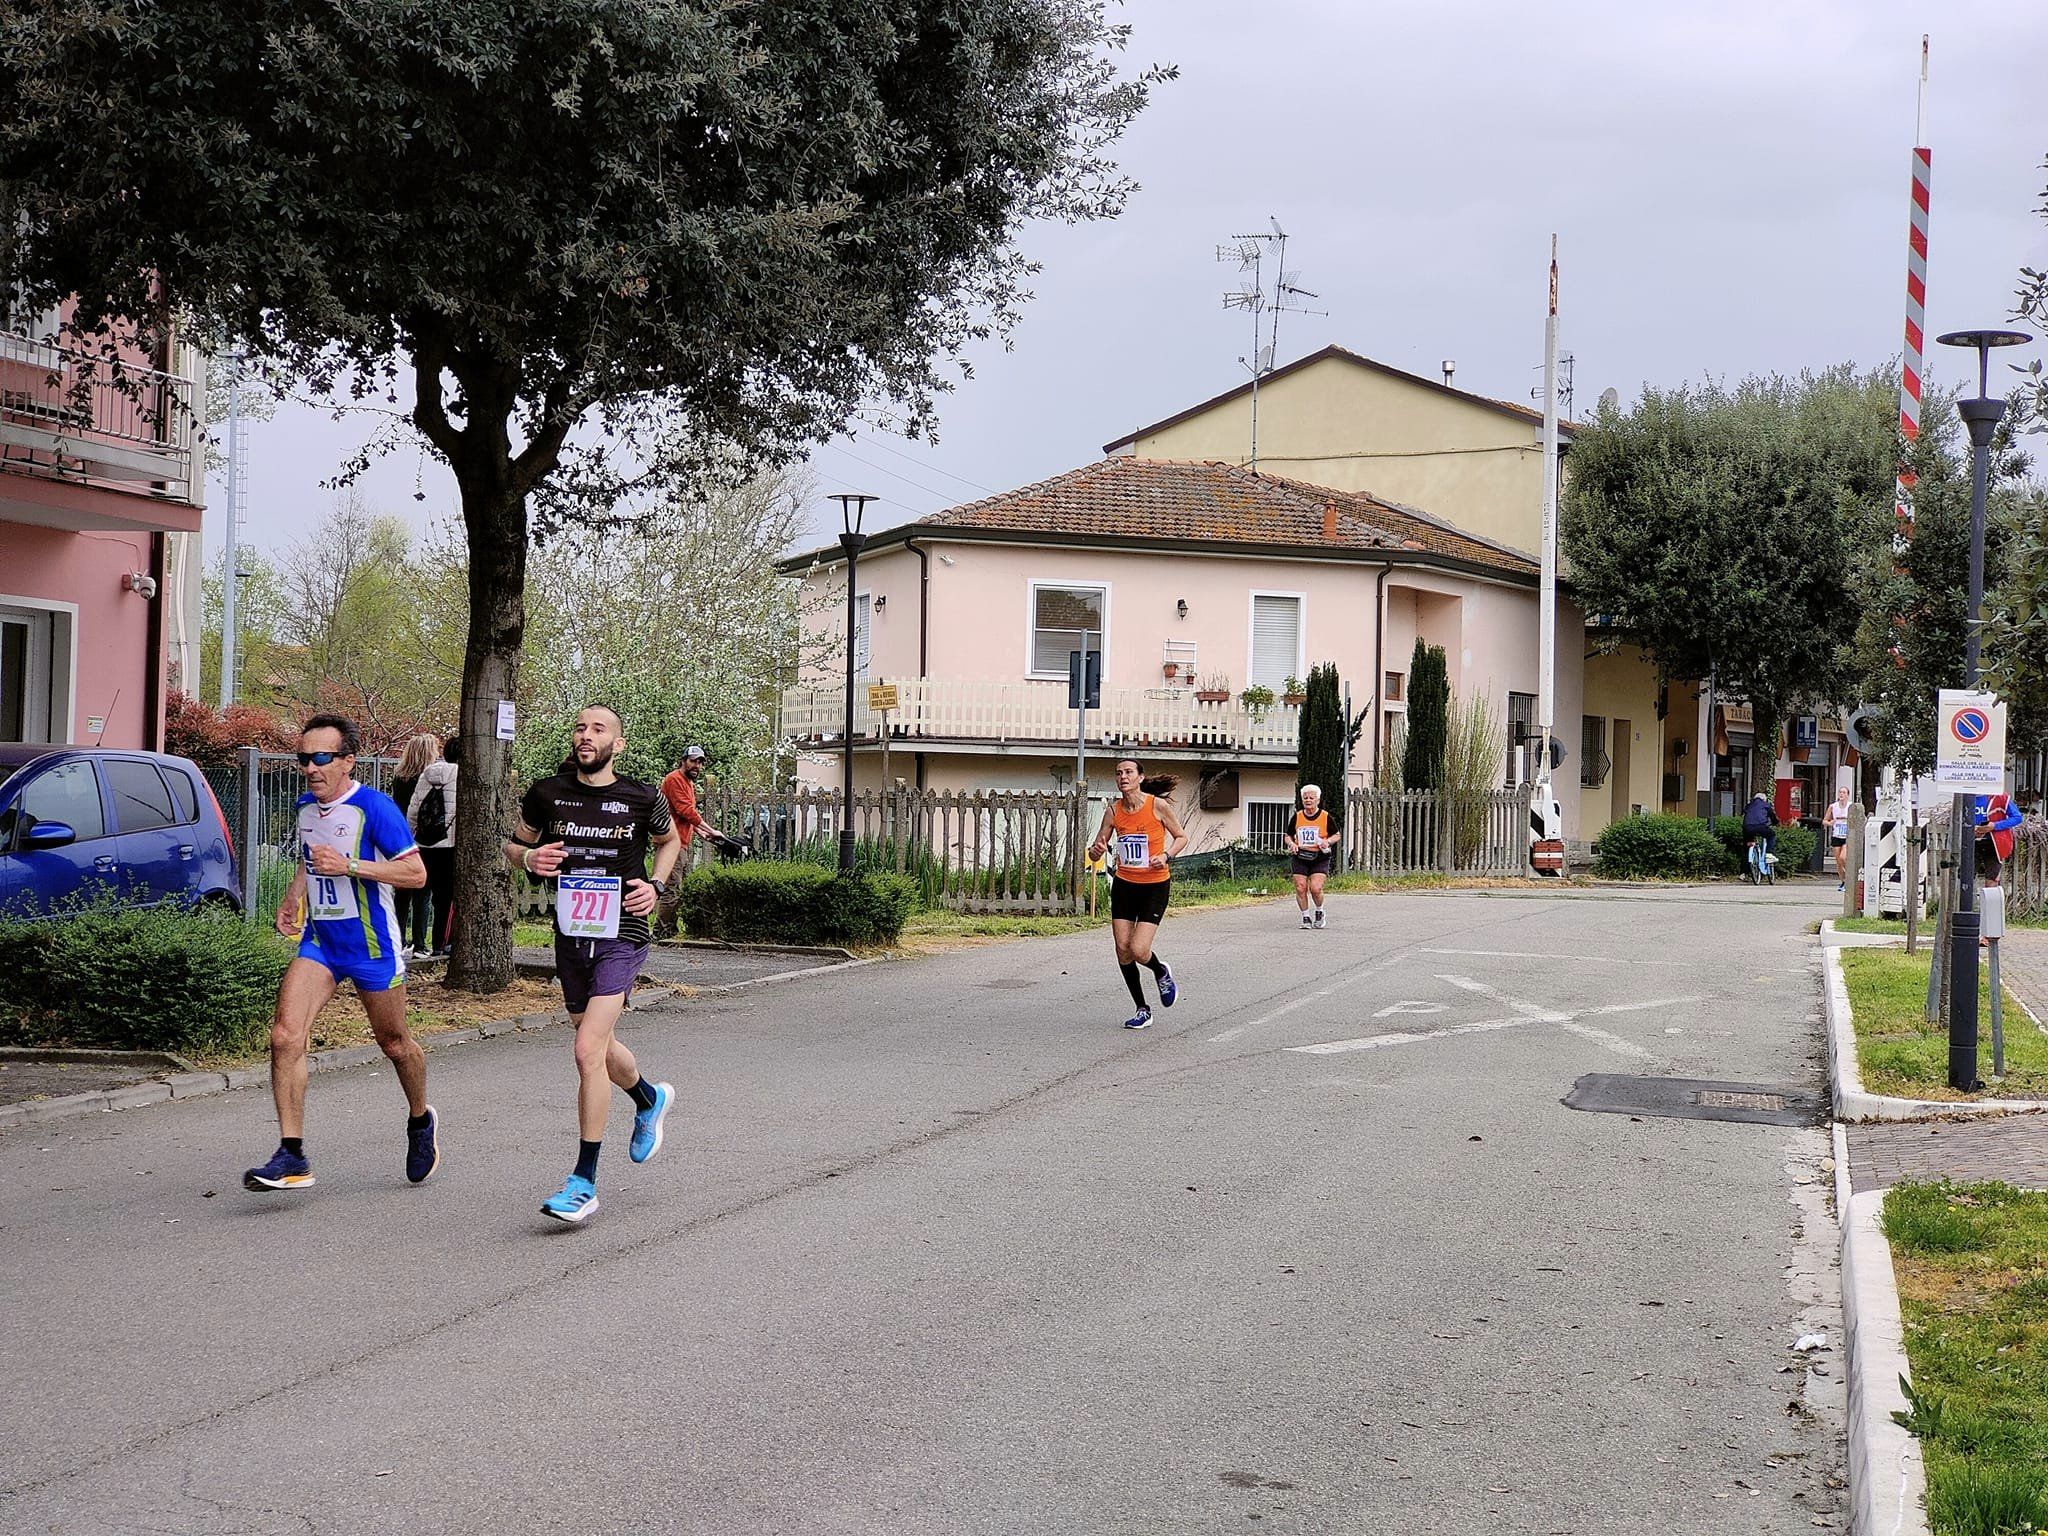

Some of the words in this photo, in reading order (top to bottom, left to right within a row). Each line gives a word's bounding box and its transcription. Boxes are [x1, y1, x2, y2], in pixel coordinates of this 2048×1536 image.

[549, 820, 625, 839] LifeRunner.it
[1302, 830, 1315, 841] 123
[1124, 843, 1142, 858] 110
[315, 878, 338, 905] 79
[571, 891, 609, 921] 227
